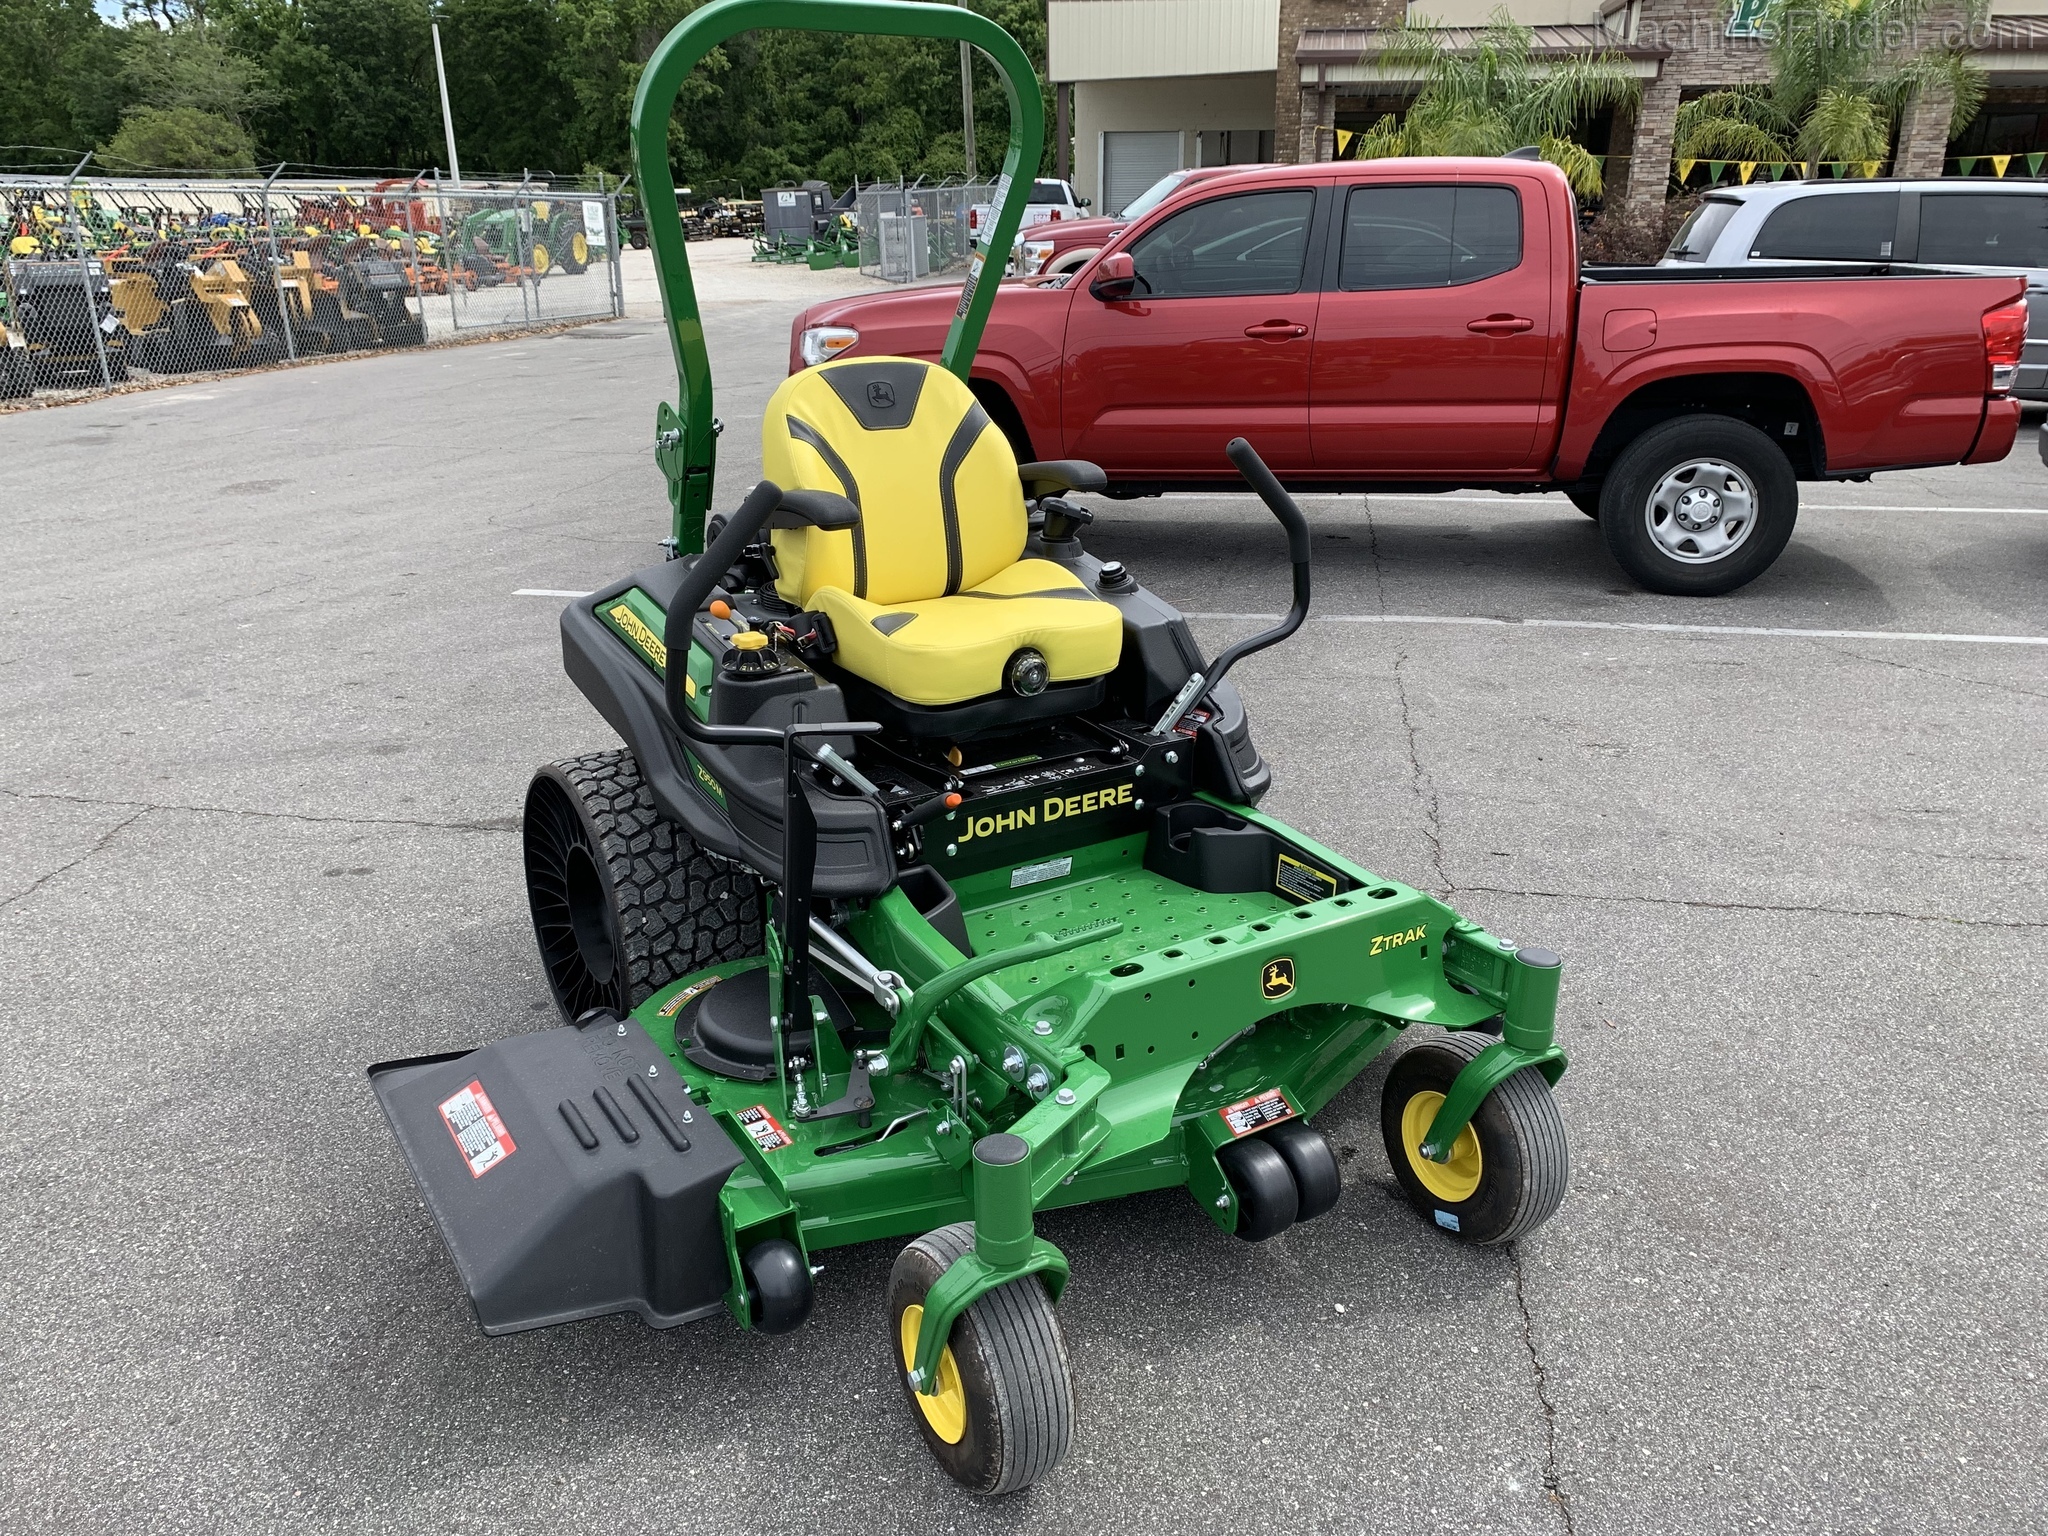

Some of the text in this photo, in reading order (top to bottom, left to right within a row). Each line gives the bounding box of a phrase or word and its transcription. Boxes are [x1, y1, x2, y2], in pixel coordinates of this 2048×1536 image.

[615, 607, 667, 666] JOHN DEERE
[957, 783, 1133, 843] JOHN DEERE
[1368, 923, 1428, 956] ZTRAK
